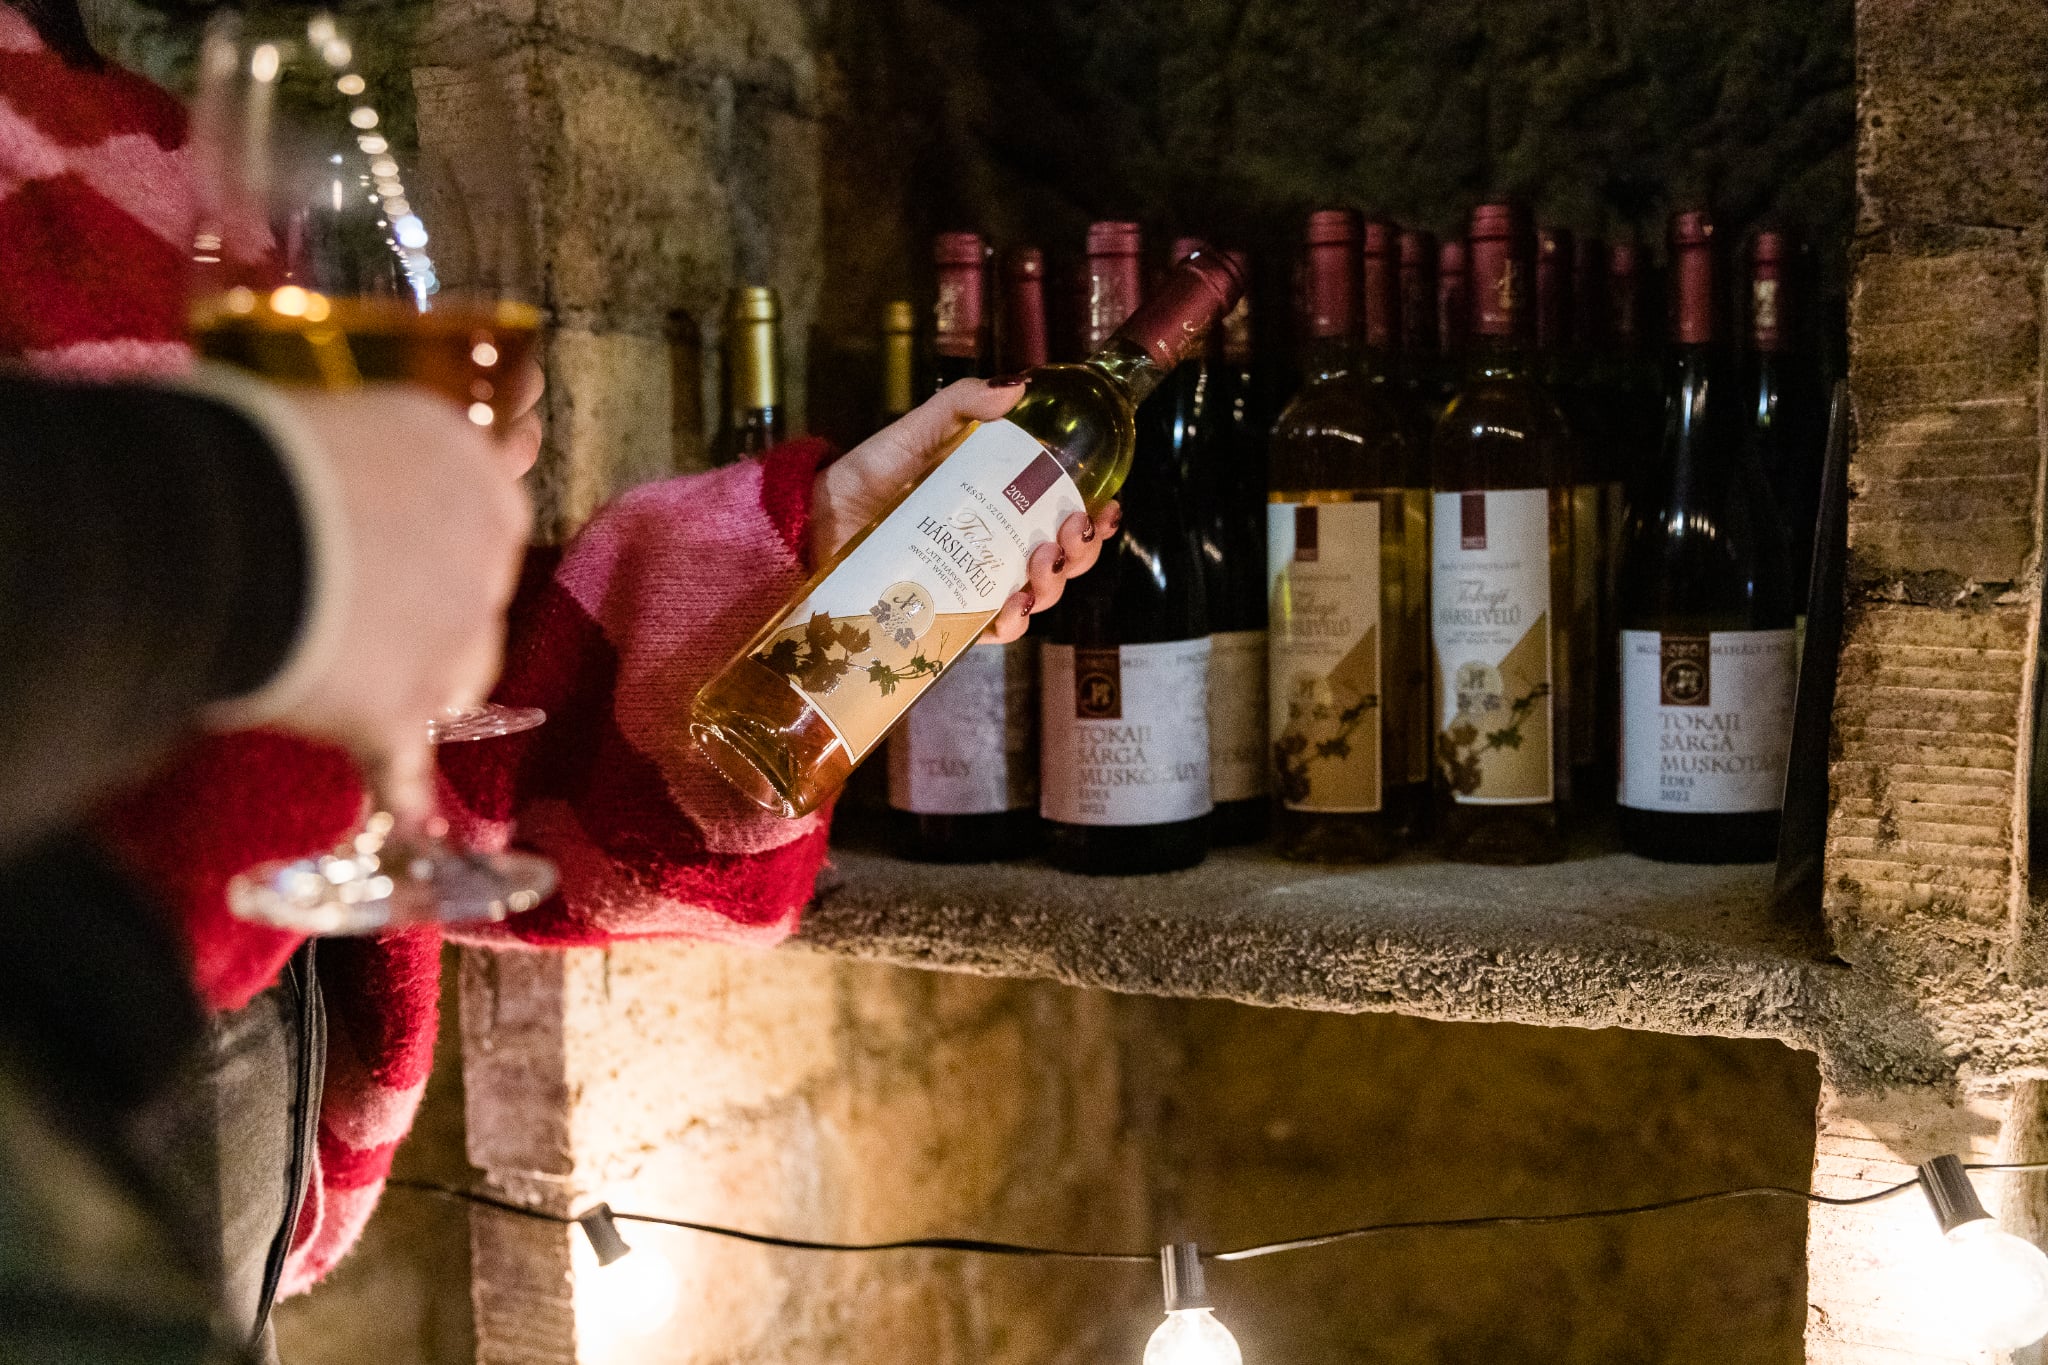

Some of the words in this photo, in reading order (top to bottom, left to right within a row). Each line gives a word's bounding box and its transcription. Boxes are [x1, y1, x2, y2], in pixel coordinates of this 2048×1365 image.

[1006, 484, 1030, 511] 2022
[946, 507, 1004, 570] Tokaji
[908, 544, 932, 564] SWEET
[933, 565, 954, 589] WHITE
[953, 588, 967, 609] WINE
[925, 547, 942, 564] LATE
[941, 562, 967, 592] HARVEST
